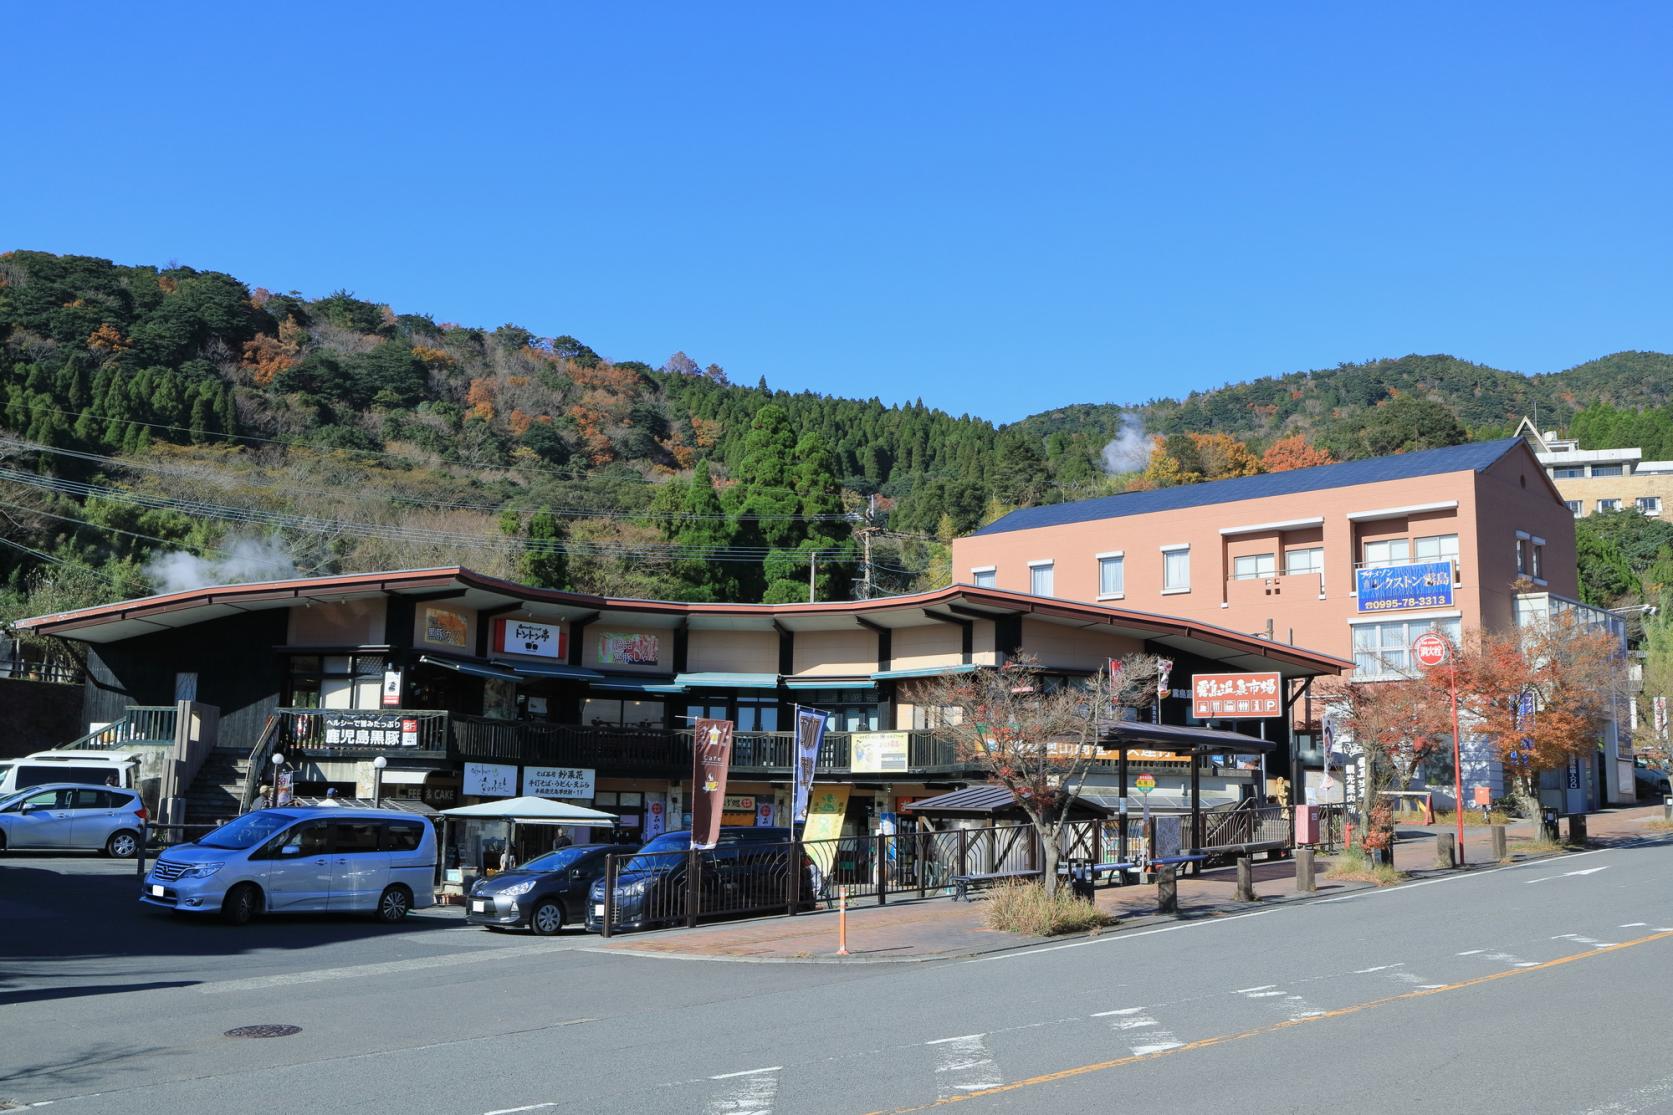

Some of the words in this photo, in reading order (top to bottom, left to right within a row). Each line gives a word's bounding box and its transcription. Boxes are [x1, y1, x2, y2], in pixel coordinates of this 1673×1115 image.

[1421, 646, 1443, 656] 消火栓
[1197, 679, 1276, 698] 霧島温泉市場
[403, 720, 416, 730] 2F
[325, 729, 400, 746] 鹿児島黒豚
[704, 754, 722, 762] Cafe
[434, 789, 455, 800] CAKE
[1345, 764, 1356, 814] 観光案内所
